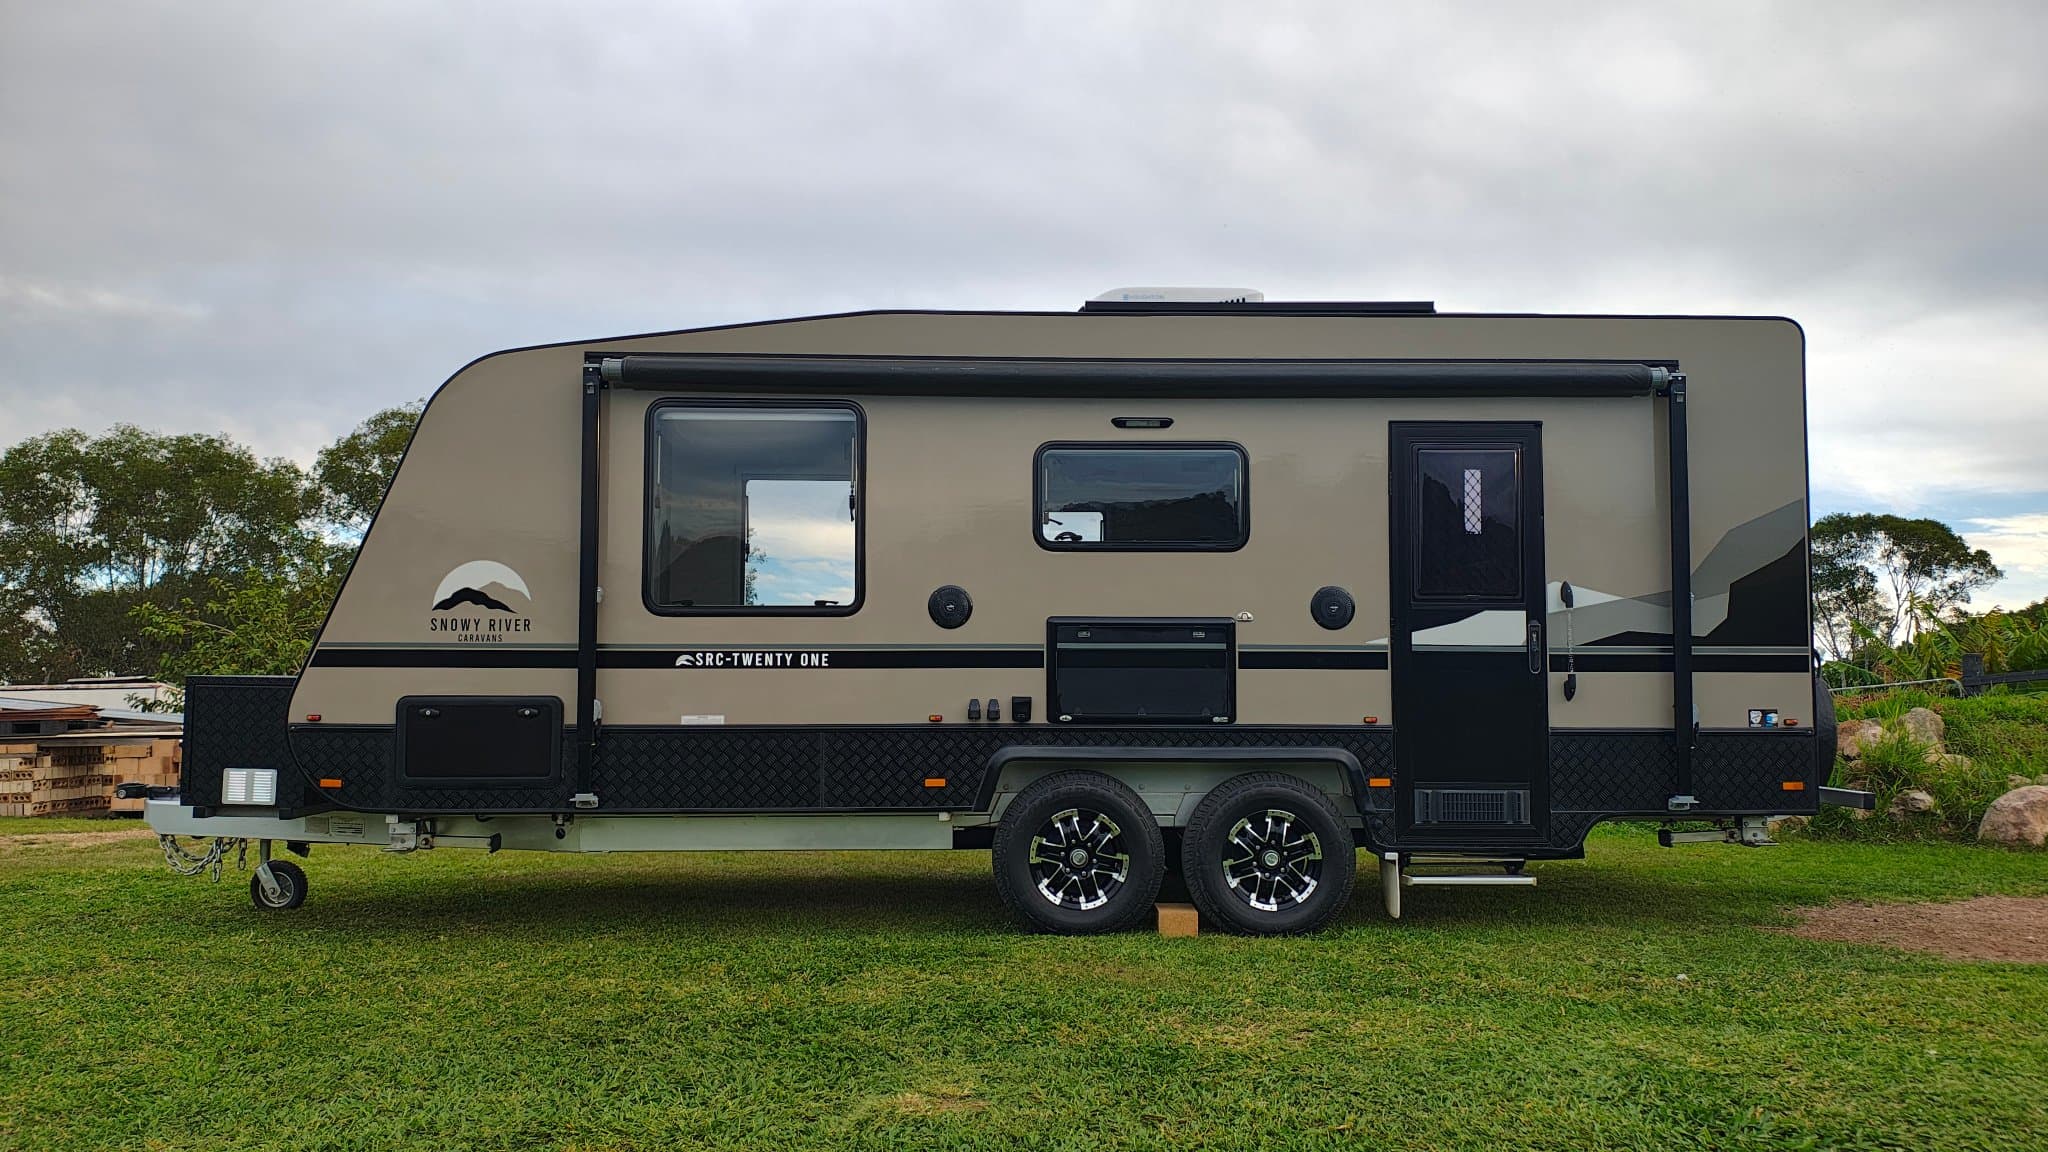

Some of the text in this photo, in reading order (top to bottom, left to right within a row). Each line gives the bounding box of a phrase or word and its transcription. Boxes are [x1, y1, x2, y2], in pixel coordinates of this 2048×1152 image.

[430, 618, 531, 632] SNOWY RIVER
[458, 633, 503, 642] CARAVANS
[695, 652, 829, 667] SRC-TWENTY ONE
